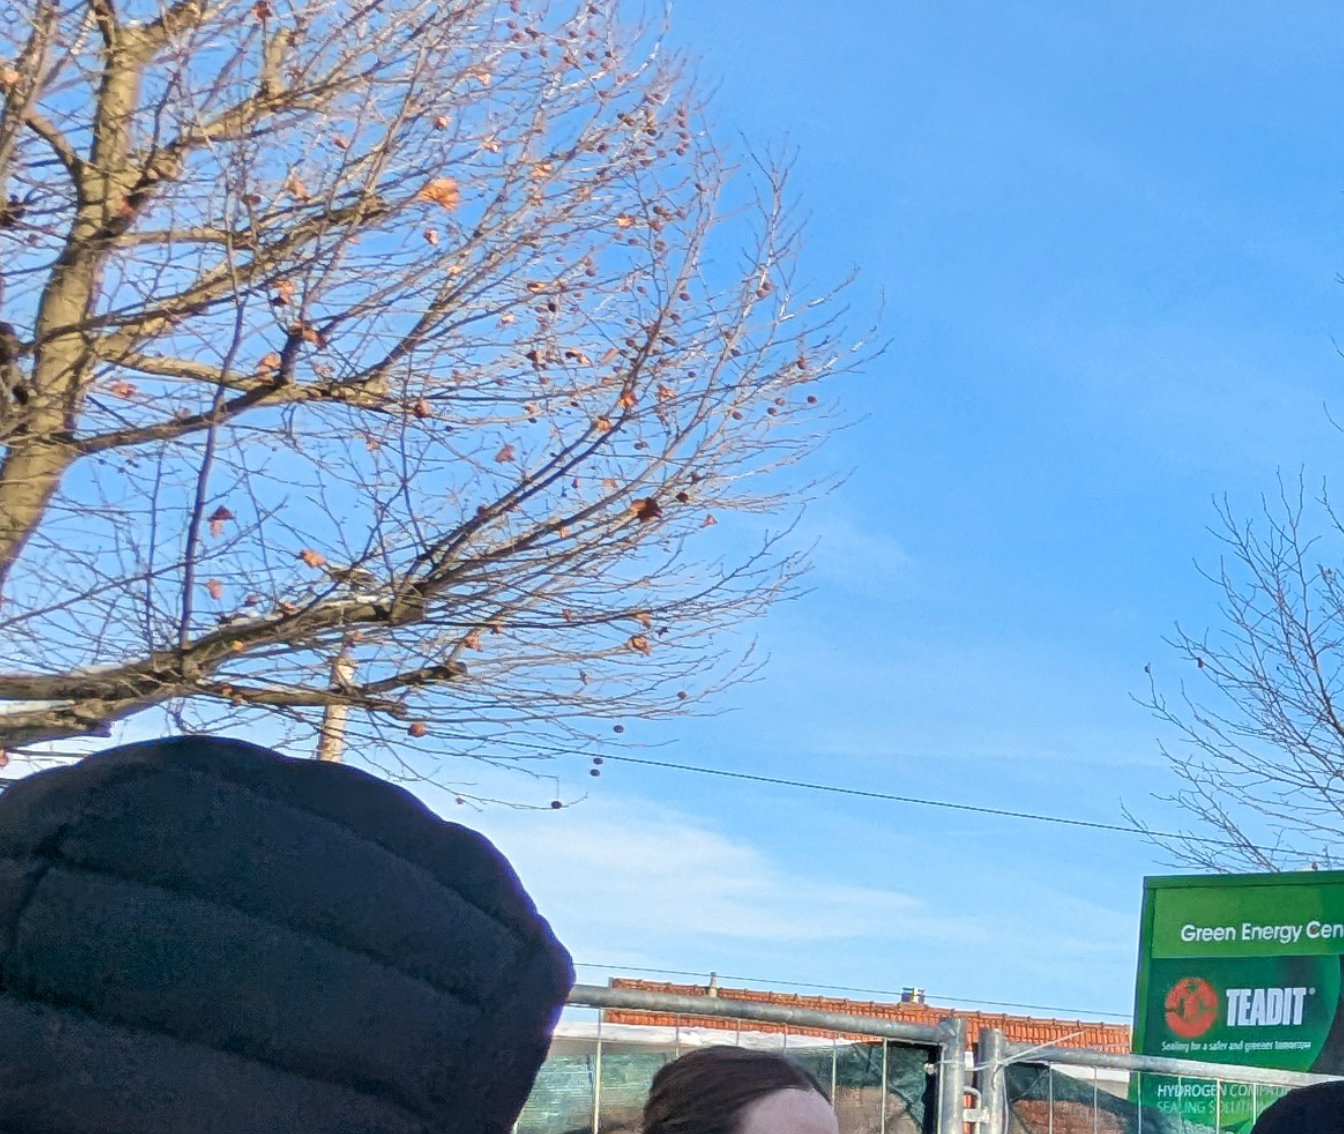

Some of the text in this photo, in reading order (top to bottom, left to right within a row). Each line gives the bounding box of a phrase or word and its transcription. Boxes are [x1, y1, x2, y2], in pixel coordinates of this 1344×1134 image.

[1181, 924, 1236, 942] Green
[1241, 922, 1303, 944] Energy
[1226, 987, 1307, 1027] TEADIT
[1161, 1040, 1312, 1053] Sealing for a safer and greener tomorrow
[1157, 1083, 1227, 1098] HYDROGEN
